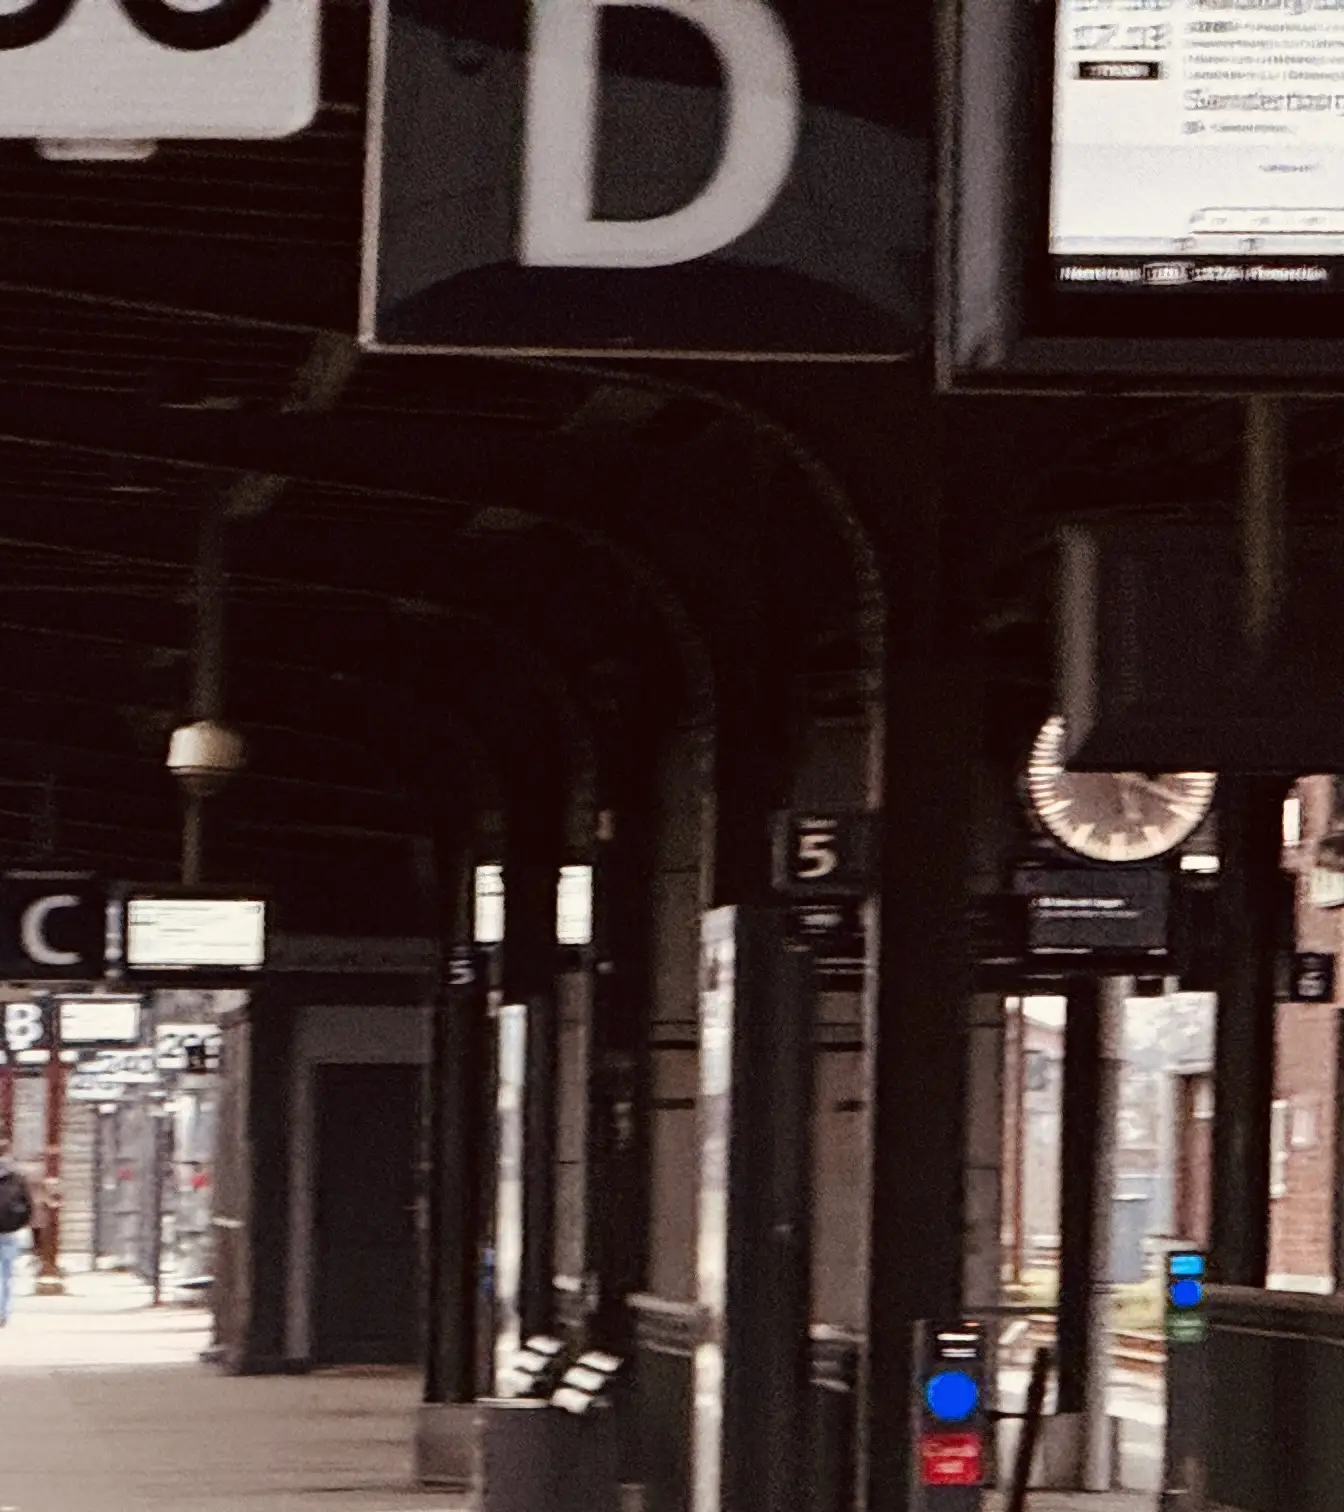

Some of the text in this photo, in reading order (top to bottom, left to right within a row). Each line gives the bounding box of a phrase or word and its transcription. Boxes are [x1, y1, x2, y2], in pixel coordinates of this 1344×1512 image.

[520, 0, 797, 269] D
[797, 833, 838, 879] 5
[19, 894, 82, 965] C
[4, 1003, 43, 1042] B
